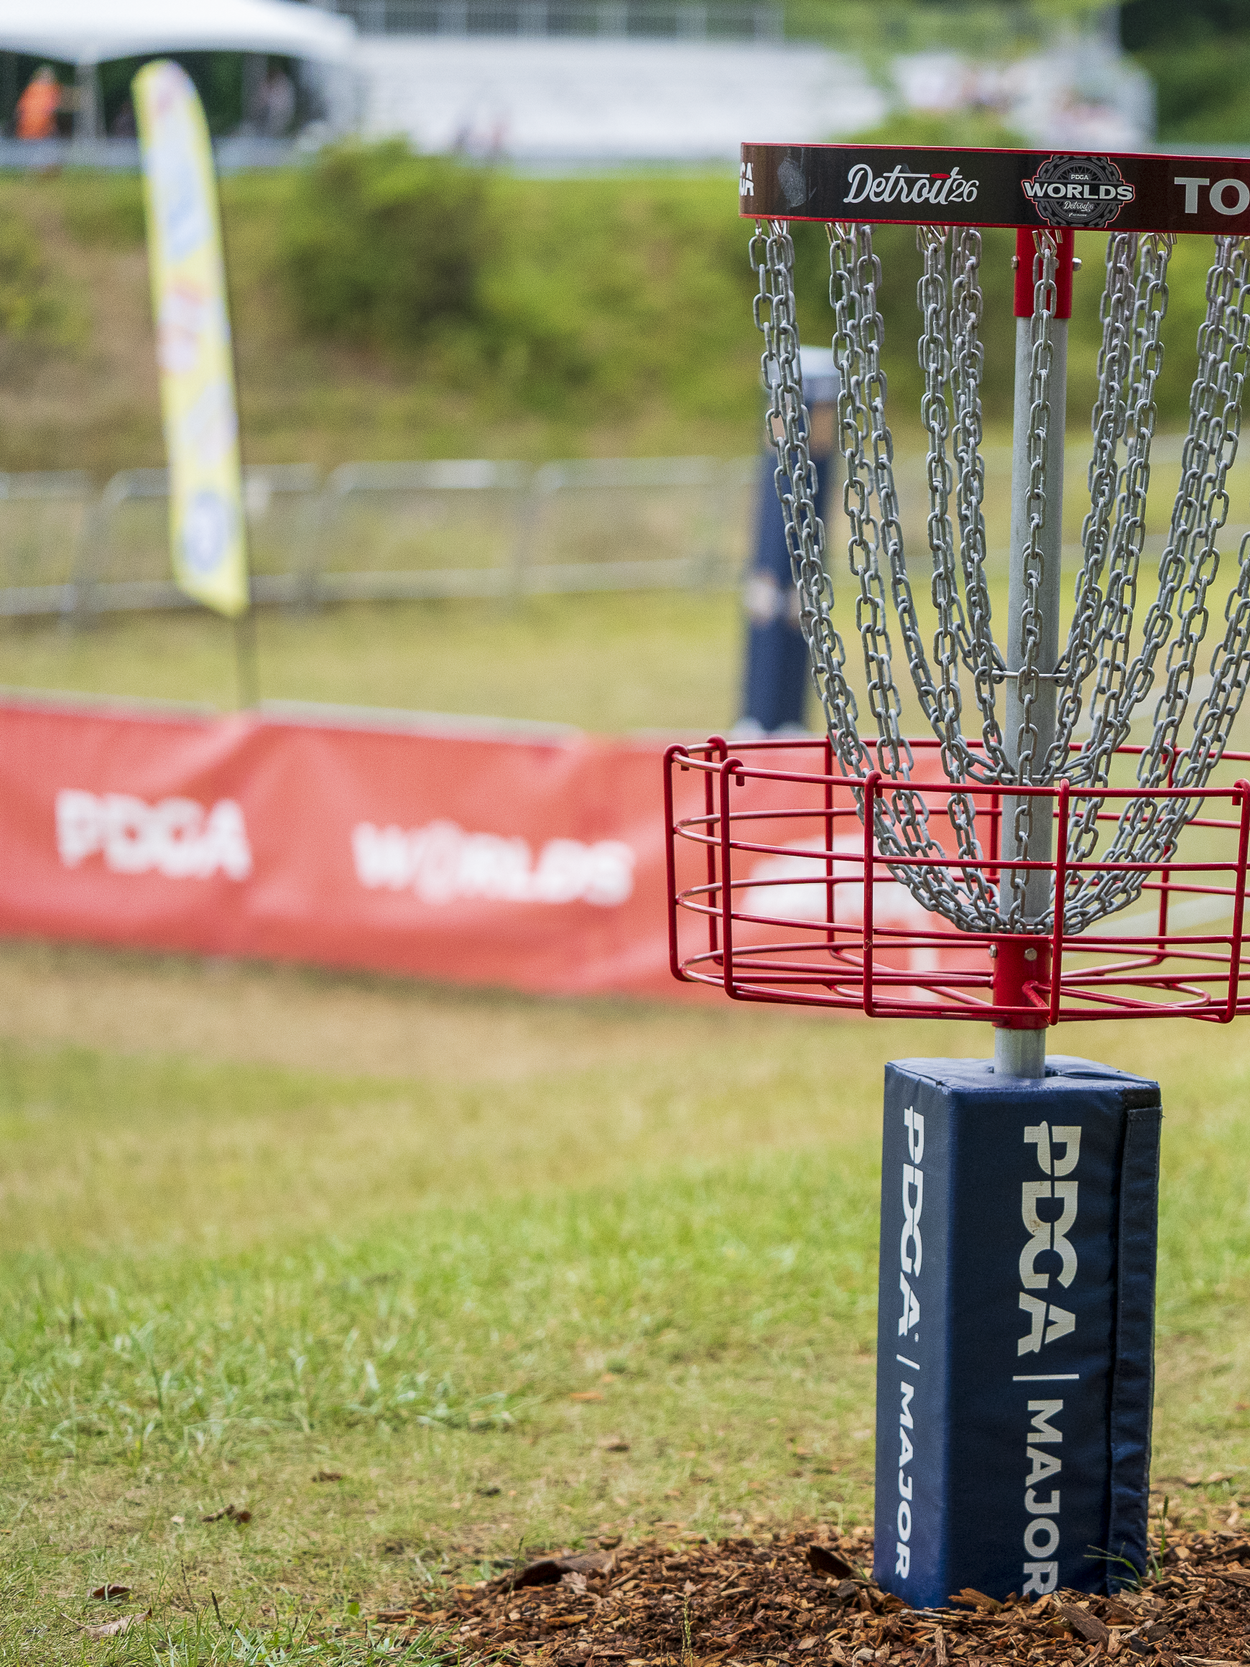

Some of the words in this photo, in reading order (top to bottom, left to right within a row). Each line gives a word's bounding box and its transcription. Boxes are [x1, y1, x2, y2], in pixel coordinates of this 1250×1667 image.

[1023, 182, 1133, 201] WORLDS
[55, 788, 251, 881] PDGA
[898, 1106, 924, 1337] PDGA
[1017, 1121, 1082, 1357] PDGA
[895, 1381, 915, 1579] MAJOR
[1022, 1399, 1064, 1595] MAJOR
